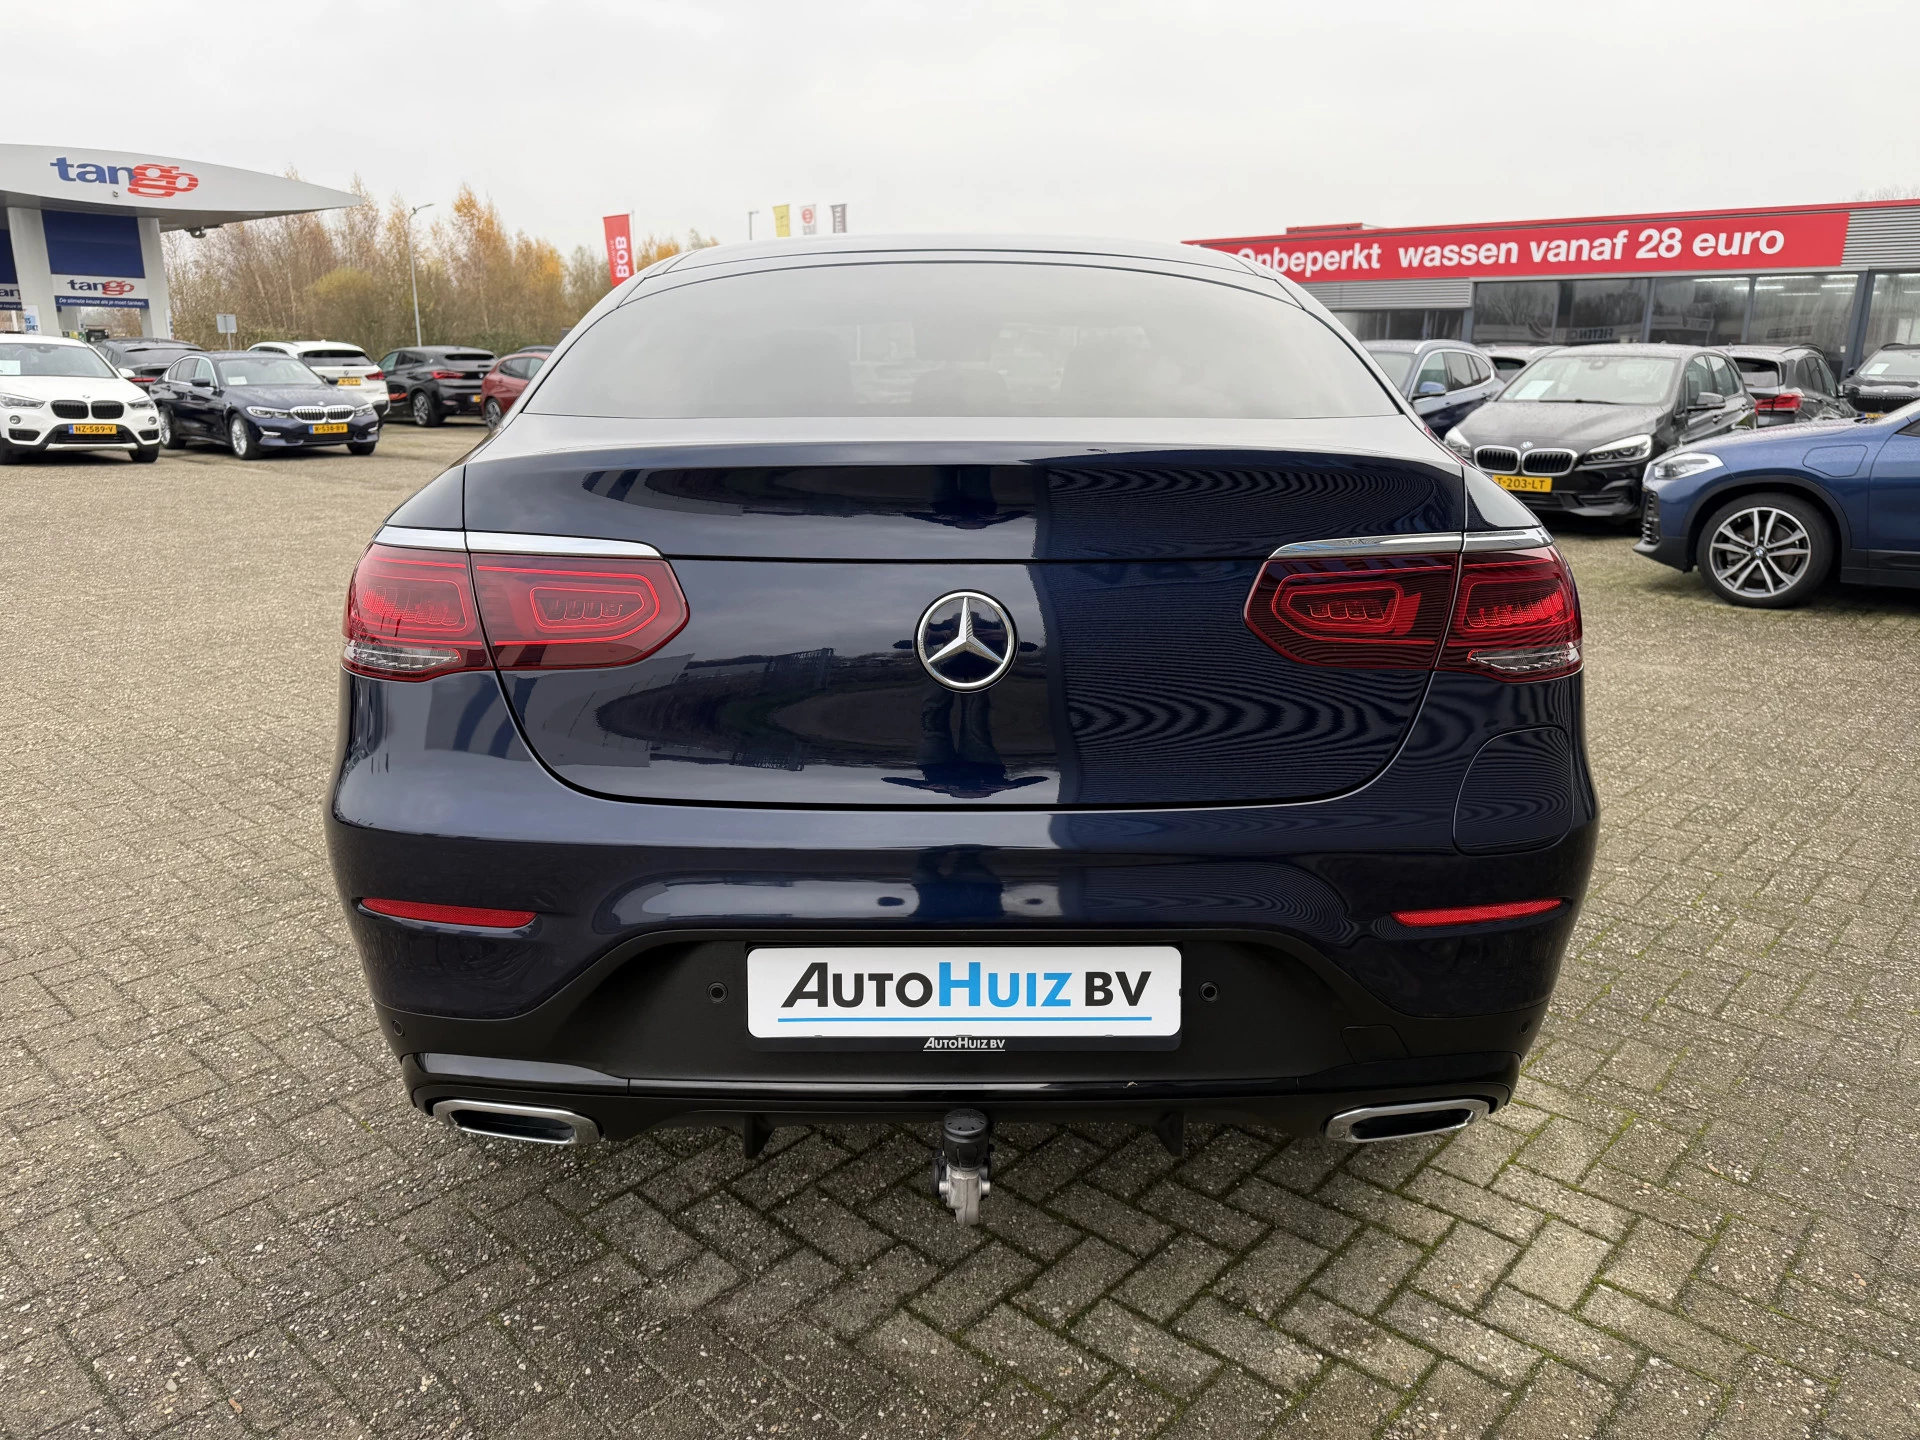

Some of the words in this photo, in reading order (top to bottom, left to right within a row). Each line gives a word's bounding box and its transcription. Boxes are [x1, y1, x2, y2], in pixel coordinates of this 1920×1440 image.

[50, 157, 199, 198] tango
[615, 236, 630, 278] BOB
[1398, 241, 1519, 268] wassen
[1530, 229, 1629, 263] vanaf
[1635, 227, 1683, 259] 28
[1692, 229, 1785, 258] euro
[67, 279, 135, 296] tango
[75, 425, 114, 433] NZ-589-V
[1497, 477, 1546, 490] T-203-LT
[1084, 971, 1153, 1007] BV
[990, 1039, 1006, 1049] BV
